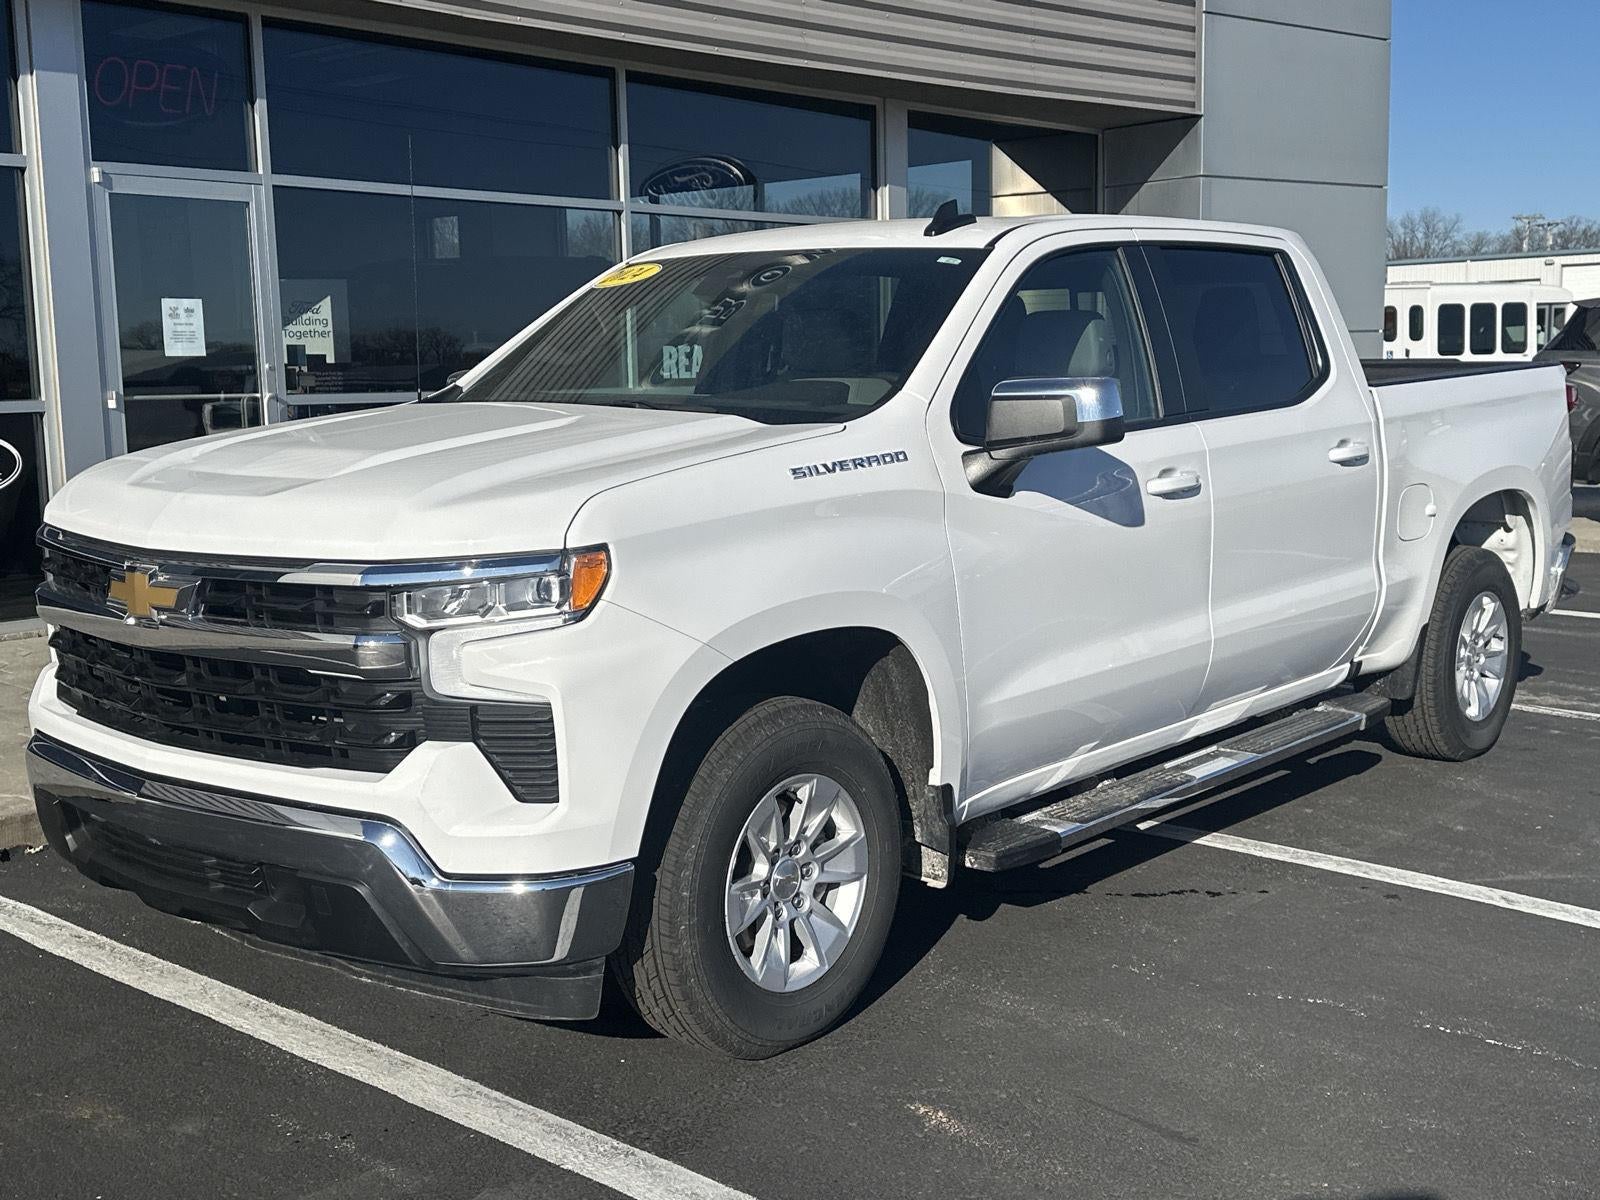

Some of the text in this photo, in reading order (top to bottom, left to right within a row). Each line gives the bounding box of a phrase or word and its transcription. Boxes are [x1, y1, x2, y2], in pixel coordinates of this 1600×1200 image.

[95, 57, 218, 116] OPEN
[283, 329, 332, 340] Together
[790, 450, 909, 480] SILVERADO
